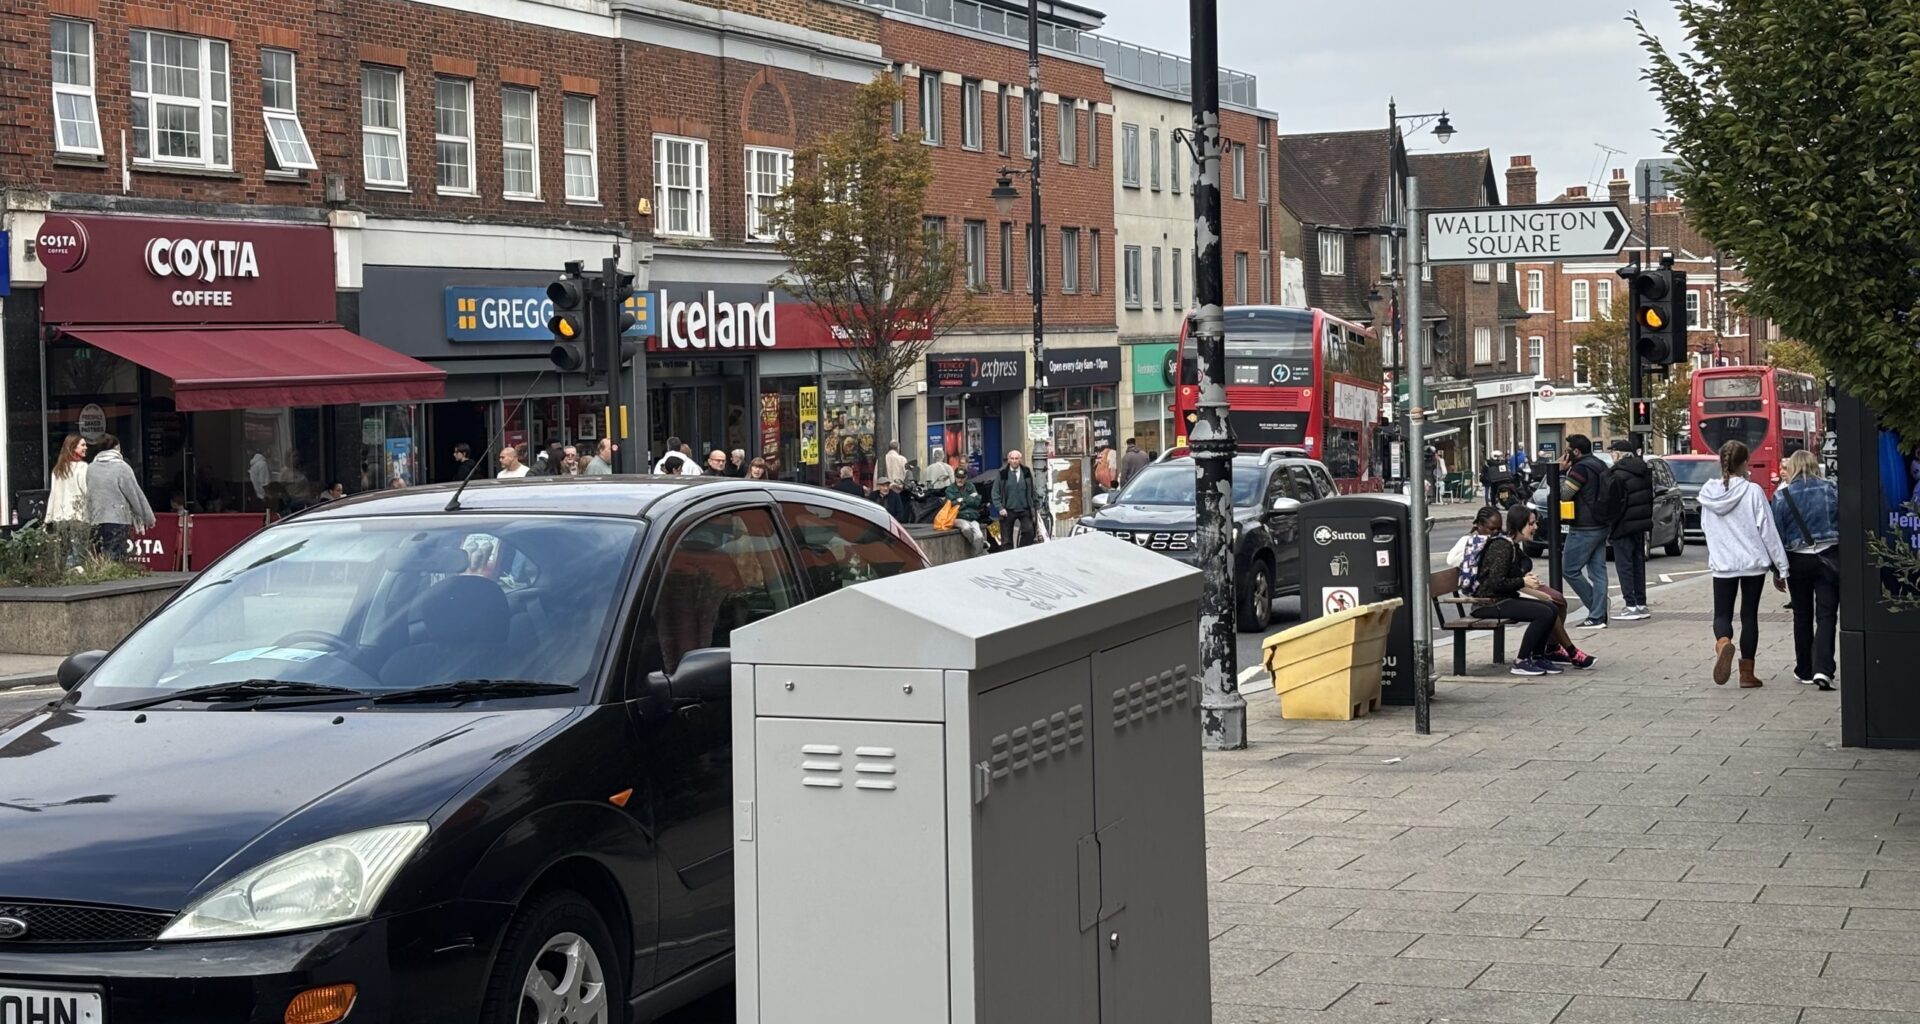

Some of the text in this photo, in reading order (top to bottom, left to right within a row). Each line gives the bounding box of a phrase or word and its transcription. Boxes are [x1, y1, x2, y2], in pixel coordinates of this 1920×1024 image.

[1434, 211, 1596, 235] WALLINGTON
[39, 235, 76, 248] COSTA
[1467, 233, 1561, 255] SQUARE
[146, 237, 260, 283] COSTA
[171, 290, 233, 306] COFFEE
[481, 298, 555, 329] GREGG
[660, 289, 776, 349] Iceland
[981, 357, 1017, 384] express
[1049, 360, 1063, 373] Open
[1063, 361, 1075, 373] every
[1075, 359, 1084, 373] day
[800, 392, 817, 409] DEAL
[1726, 418, 1740, 427] 127
[1331, 530, 1366, 541] Sutton
[126, 538, 164, 556] OSTA
[1381, 656, 1397, 667] OU
[1381, 670, 1397, 678] eep
